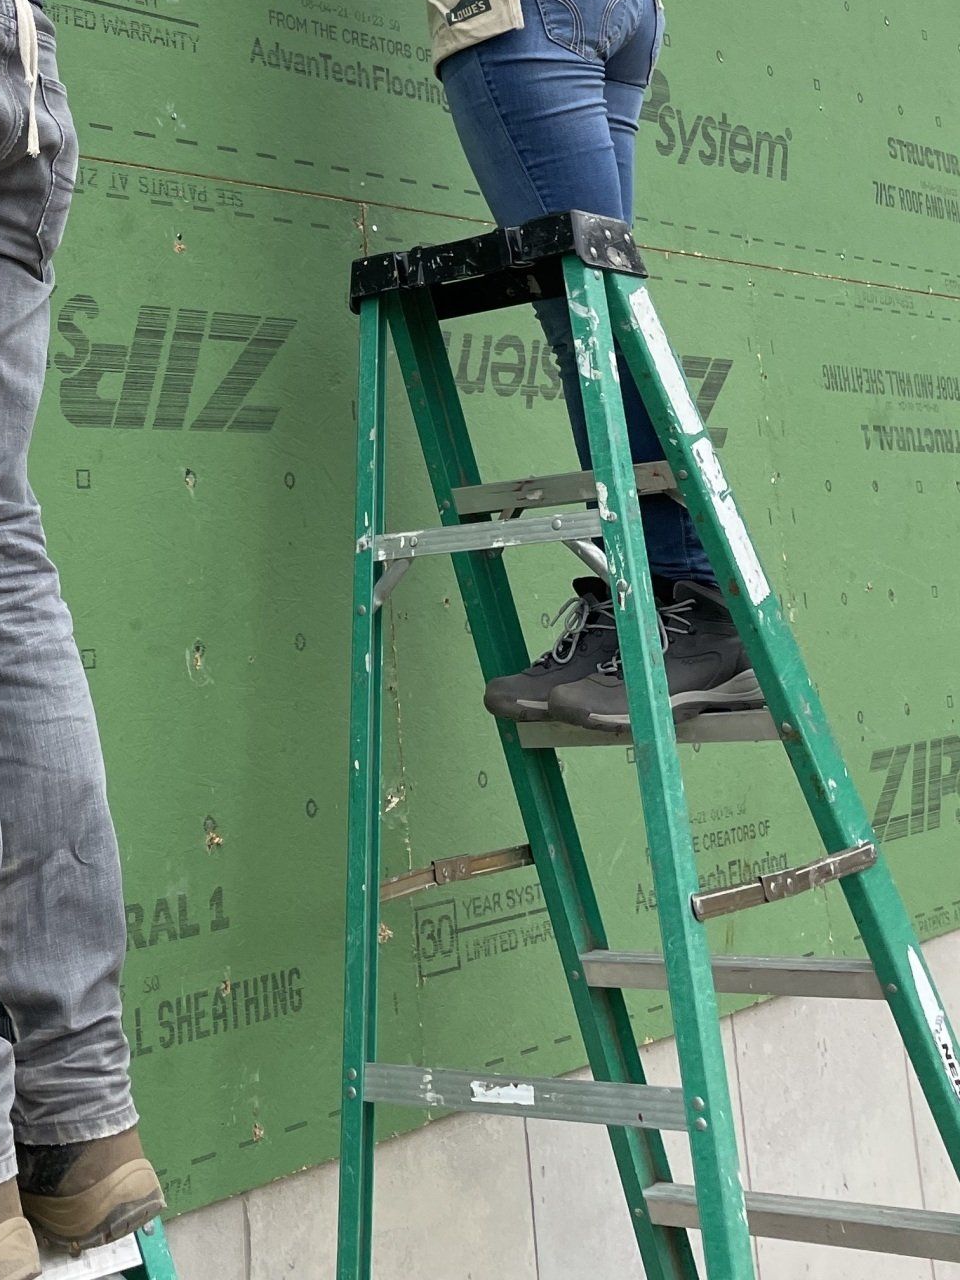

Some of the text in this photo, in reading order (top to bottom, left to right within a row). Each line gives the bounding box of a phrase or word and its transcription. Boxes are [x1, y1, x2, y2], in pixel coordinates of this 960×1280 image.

[450, 0, 487, 23] LOWE'S
[100, 13, 200, 53] WARRANTY
[268, 9, 432, 63] FROM THE CREATORS OF
[655, 104, 789, 182] system
[887, 136, 960, 177] STRUCTUR
[898, 187, 924, 215] ROOF
[925, 193, 945, 220] AND
[59, 305, 298, 434] ZIP
[822, 364, 886, 396] SHEATHING
[884, 369, 914, 399] WALL
[913, 373, 934, 400] AND
[860, 424, 871, 451] 1
[703, 822, 757, 851] CREATORS
[758, 819, 771, 837] OF
[462, 883, 541, 920] YEAR SYST
[420, 914, 455, 962] 30
[465, 928, 519, 963] LIMITED
[158, 967, 305, 1050] SHEATHING
